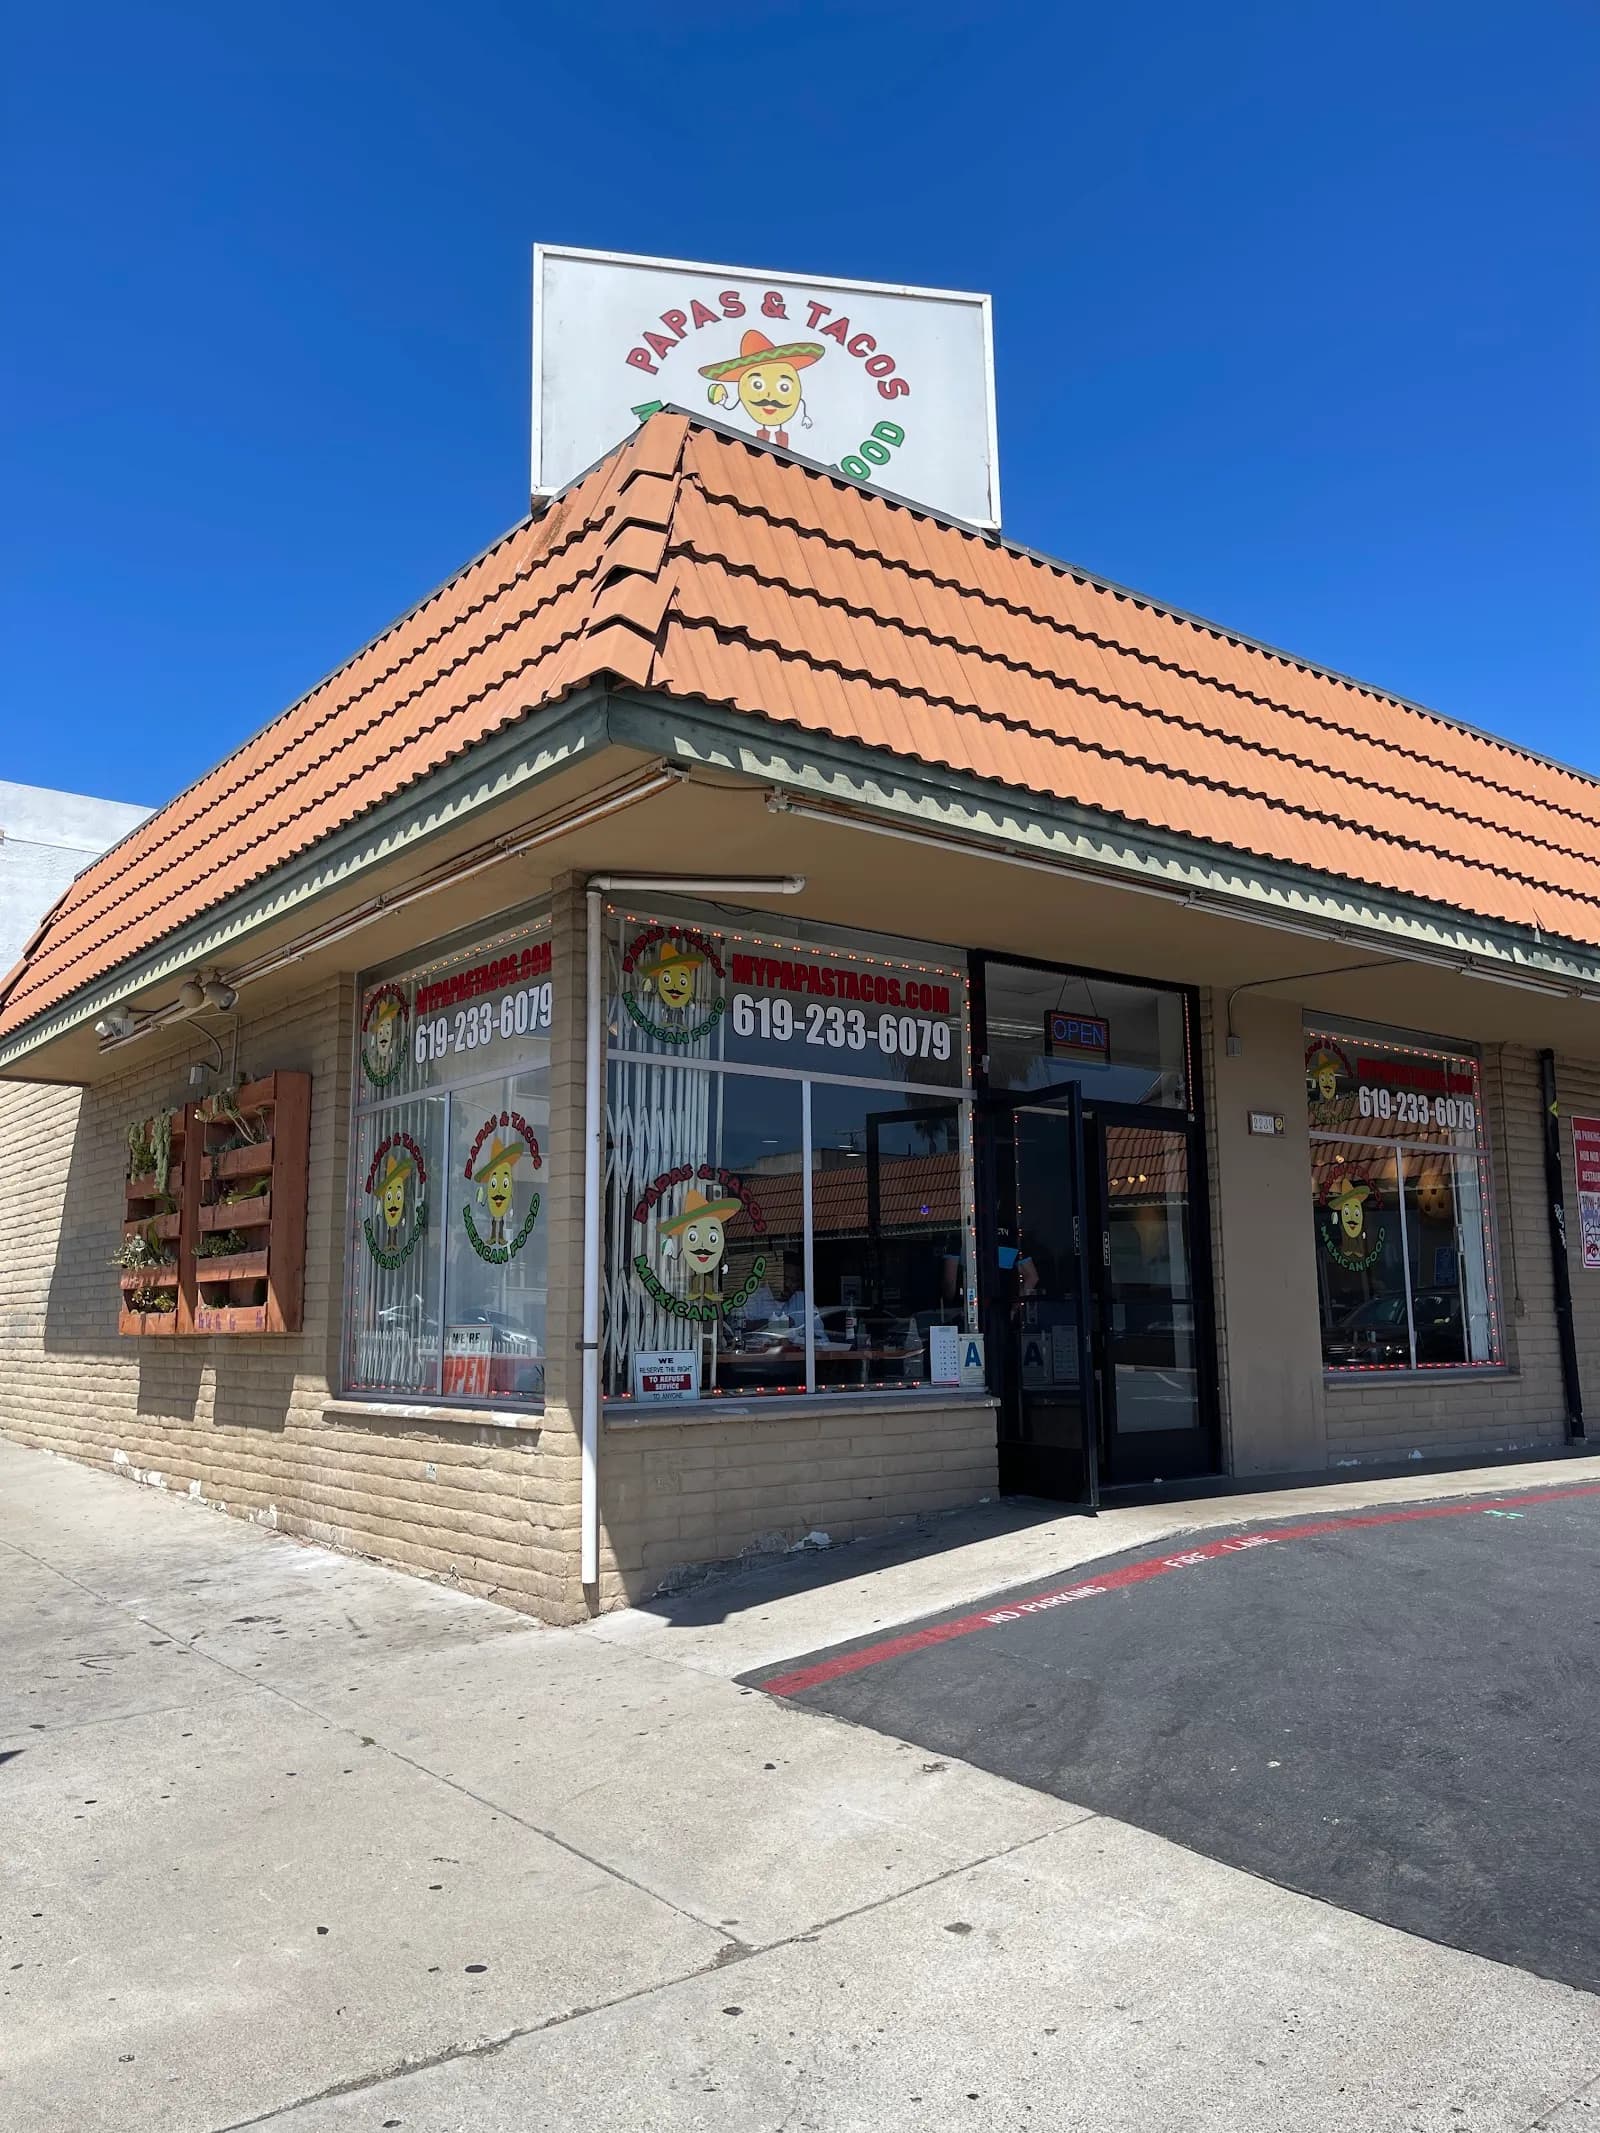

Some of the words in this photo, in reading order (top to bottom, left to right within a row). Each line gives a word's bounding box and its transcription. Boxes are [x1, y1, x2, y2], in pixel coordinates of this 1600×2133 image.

[625, 291, 746, 375] PAPAS
[761, 291, 790, 320] &
[806, 300, 910, 400] TACOS
[831, 421, 906, 481] OOD
[732, 953, 950, 1014] MYPAPASTACOS.COM
[415, 982, 552, 1064] 619-233-6079
[622, 991, 689, 1044] MEXICAN
[690, 997, 726, 1041] FOOD
[732, 994, 951, 1060] 619-233-6079
[1053, 1020, 1105, 1046] OPEN
[1359, 1085, 1475, 1130] 619-233-6079
[511, 1111, 542, 1169] TACOS
[633, 1163, 693, 1224] PAPAS
[697, 1164, 715, 1180] &
[717, 1168, 767, 1232] TACOS
[463, 1204, 509, 1265] MEXICAN
[510, 1192, 541, 1258] FOOD
[1321, 1224, 1363, 1271] MEXICAN
[1366, 1227, 1385, 1267] FOOD
[633, 1254, 719, 1321] MEXICAN
[721, 1255, 766, 1315] FOOD
[660, 1375, 684, 1383] REFUSE
[964, 1341, 982, 1367] A
[981, 1610, 1021, 1625] NO
[1017, 1585, 1107, 1613] PARKING
[1162, 1551, 1215, 1569] FIRE
[1222, 1535, 1279, 1551] LANE
